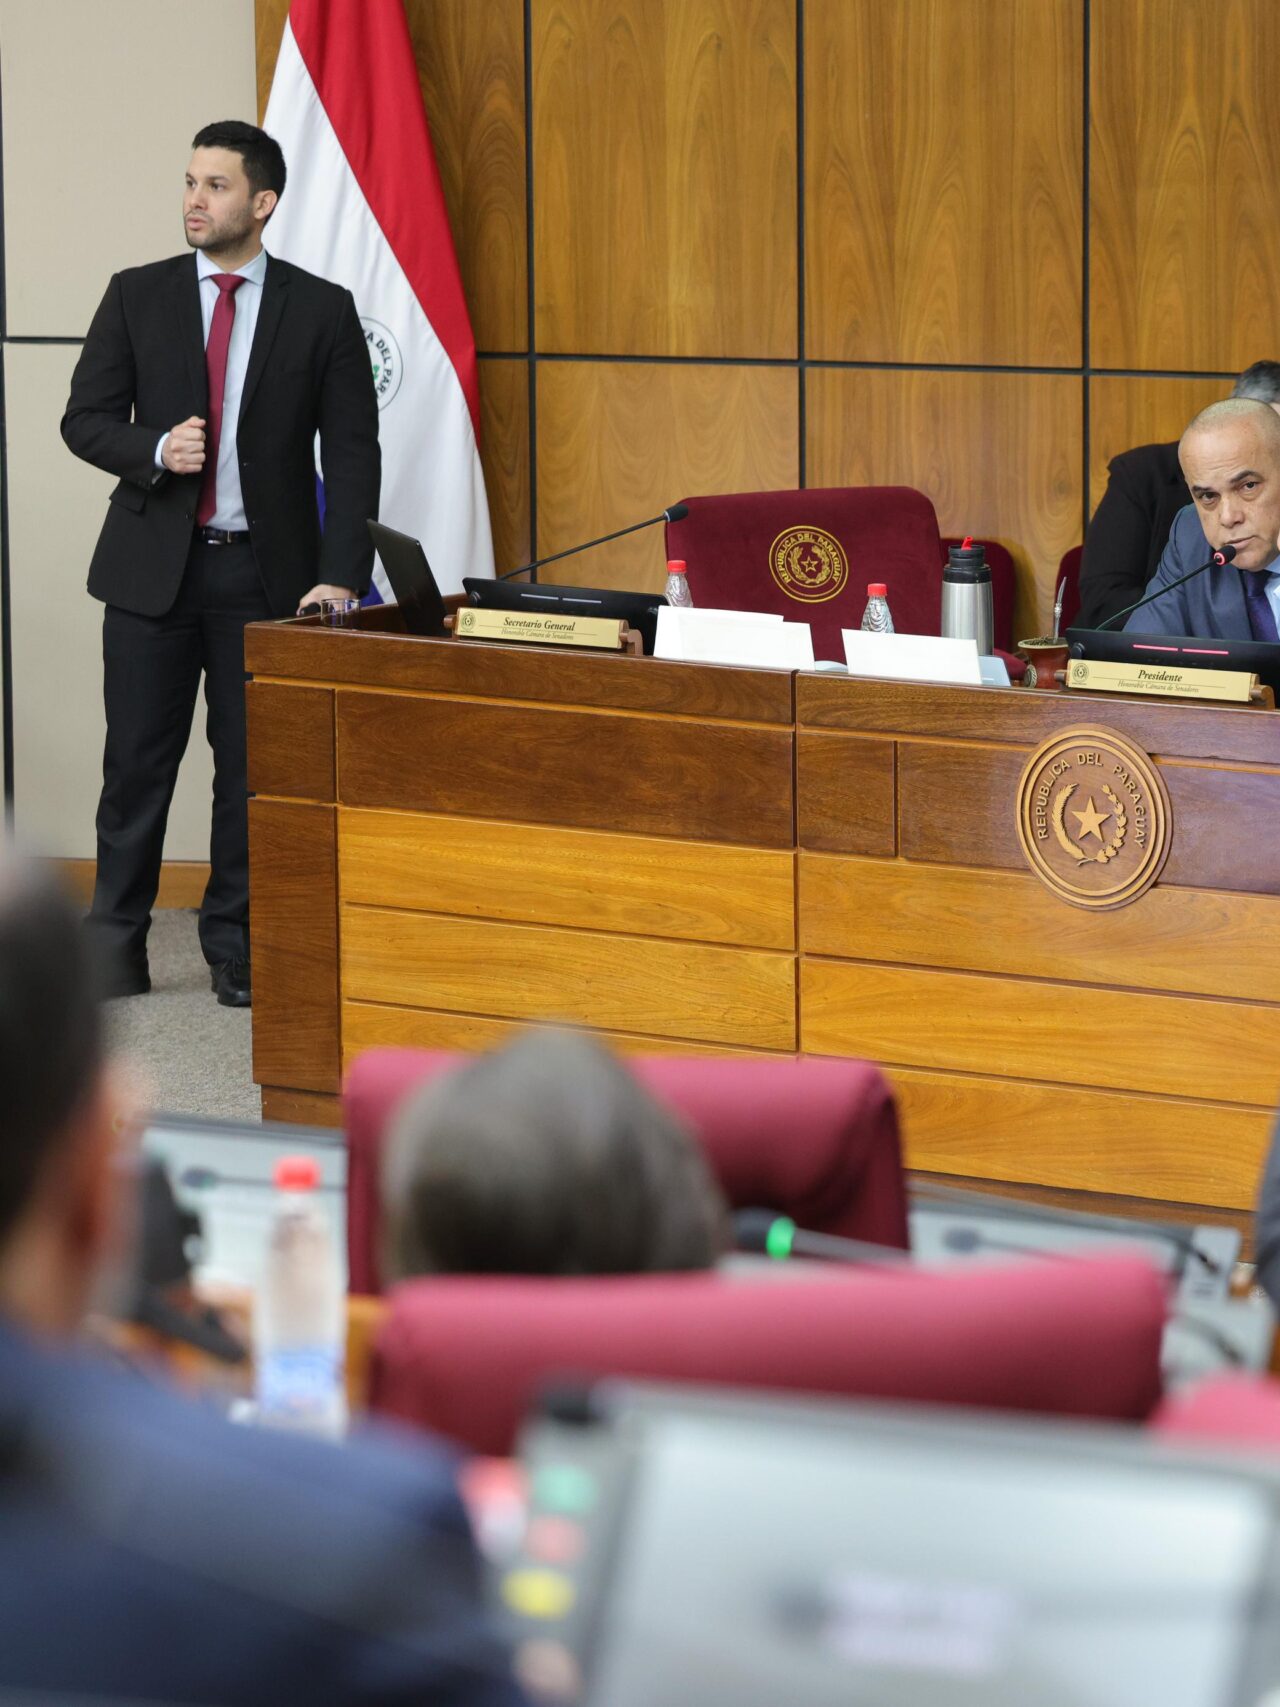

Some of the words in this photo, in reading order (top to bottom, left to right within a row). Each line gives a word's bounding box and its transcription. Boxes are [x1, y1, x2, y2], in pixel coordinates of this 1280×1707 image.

[376, 339, 391, 364] DEL
[777, 535, 797, 584] REPUBLICA
[797, 533, 816, 541] DEL
[817, 536, 841, 582] PARAGUAY
[504, 617, 542, 629] Secretario
[544, 620, 576, 632] General
[1138, 669, 1183, 682] Presidente
[1035, 758, 1071, 840] REPUBLICA
[1077, 753, 1103, 766] DEL
[1113, 765, 1146, 848] PARAGUAY
